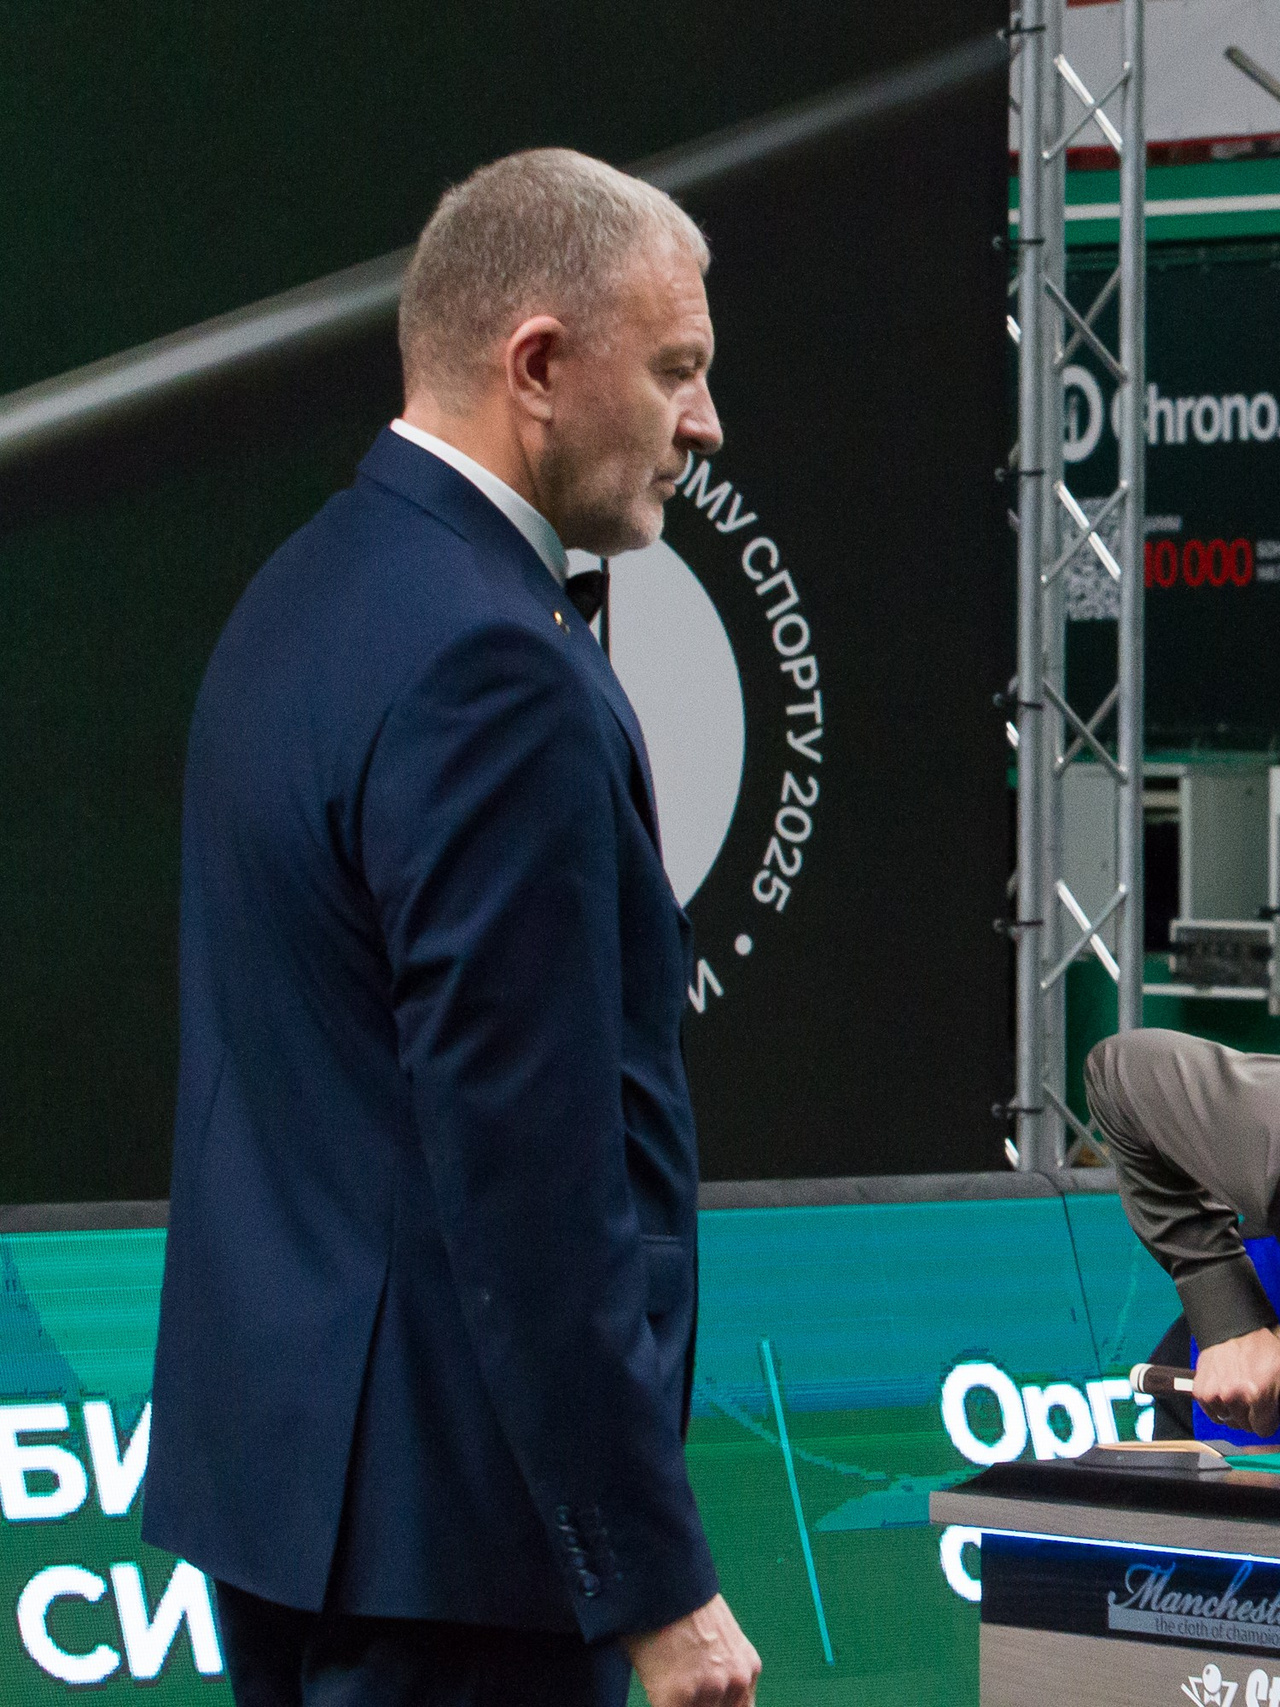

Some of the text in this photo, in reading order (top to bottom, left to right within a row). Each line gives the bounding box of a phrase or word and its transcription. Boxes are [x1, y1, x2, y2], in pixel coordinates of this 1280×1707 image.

[1182, 537, 1253, 588] 000
[673, 449, 823, 913] МУ СПОРТУ 2025
[0, 1399, 152, 1521] БИ
[940, 1361, 1155, 1466] Орг
[17, 1558, 224, 1685] СИ
[1155, 1618, 1176, 1634] the
[1179, 1619, 1208, 1637] cloth
[1212, 1621, 1224, 1639] of
